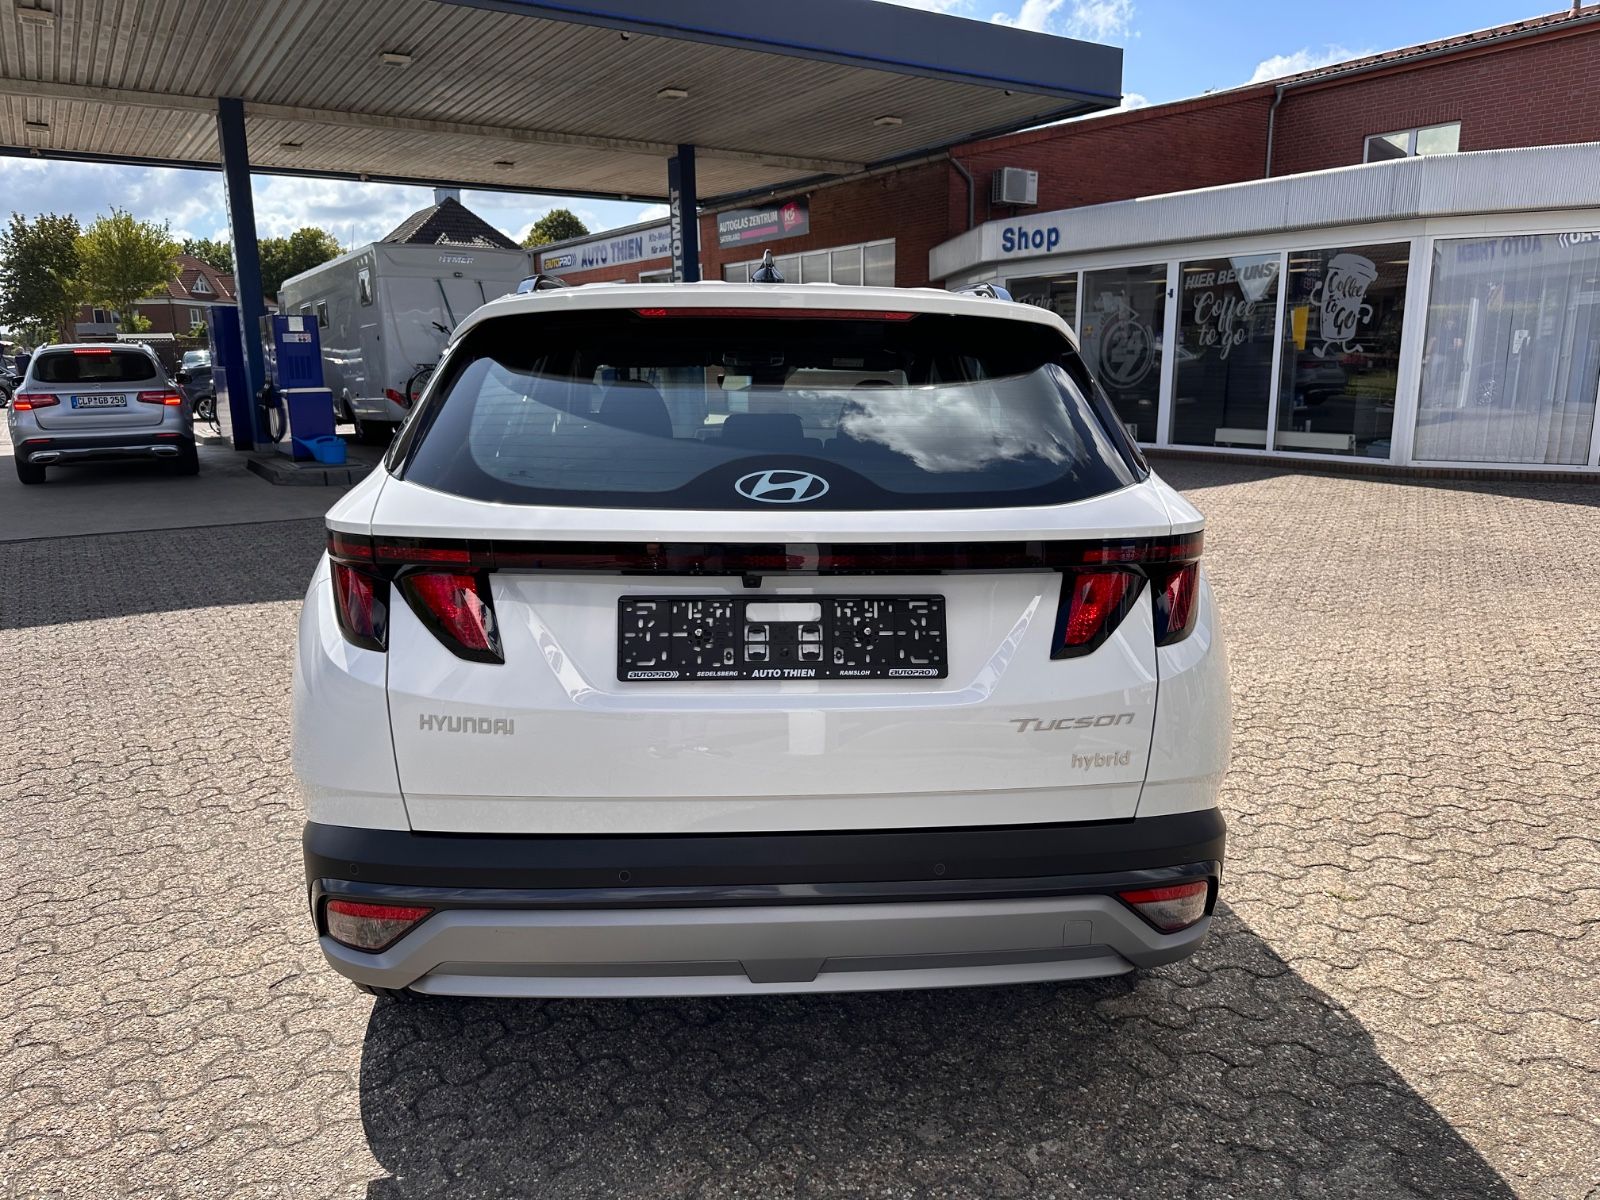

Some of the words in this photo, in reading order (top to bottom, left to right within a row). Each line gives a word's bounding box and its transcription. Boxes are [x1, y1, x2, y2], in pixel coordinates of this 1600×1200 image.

[719, 217, 749, 233] AUTOGLAS
[749, 210, 778, 227] ZENTRUM
[581, 248, 608, 268] AUTO
[610, 236, 643, 263] THIEN
[1002, 226, 1060, 252] Shop
[1184, 271, 1214, 290] HIER
[1243, 262, 1275, 281] UNS
[1328, 271, 1363, 300] Coffee
[1194, 291, 1256, 333] Coffee
[1198, 324, 1218, 346] to
[1220, 328, 1246, 360] go
[77, 395, 93, 405] CLP
[99, 394, 109, 404] GB
[110, 394, 124, 404] 258
[628, 671, 673, 679] AUTOPRO
[751, 669, 781, 678] AUTO
[783, 668, 816, 677] THIEN
[889, 668, 932, 676] AUTOPRO
[419, 713, 515, 735] HYUNDAI
[1071, 750, 1131, 771] hybrid
